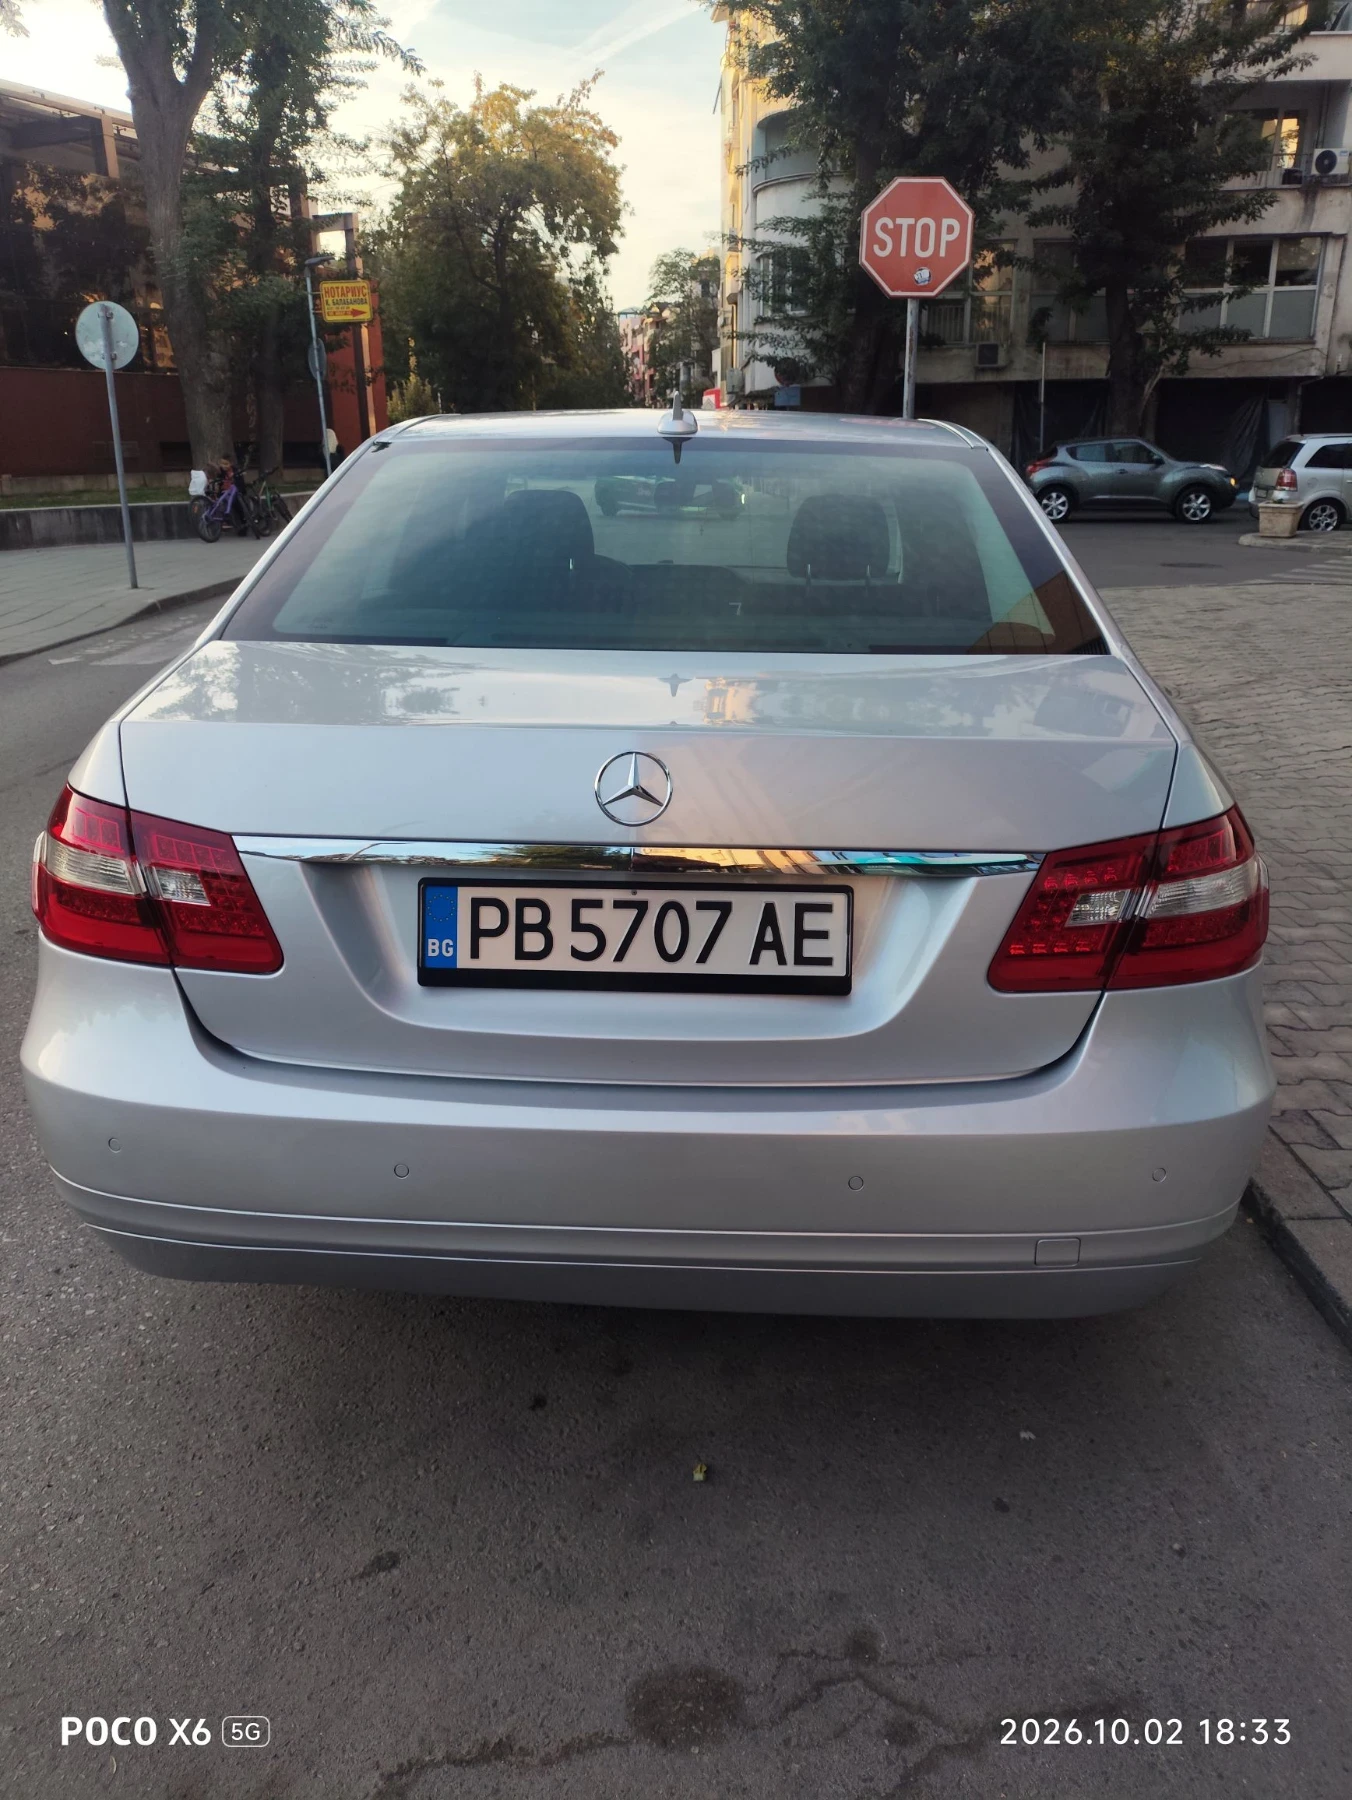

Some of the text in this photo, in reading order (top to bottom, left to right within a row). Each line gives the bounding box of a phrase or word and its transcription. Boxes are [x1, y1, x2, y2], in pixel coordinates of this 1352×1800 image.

[873, 217, 960, 257] STOP
[324, 285, 367, 298] НОТАРИУС
[470, 897, 834, 967] PB 5707 AE
[427, 938, 454, 957] BG
